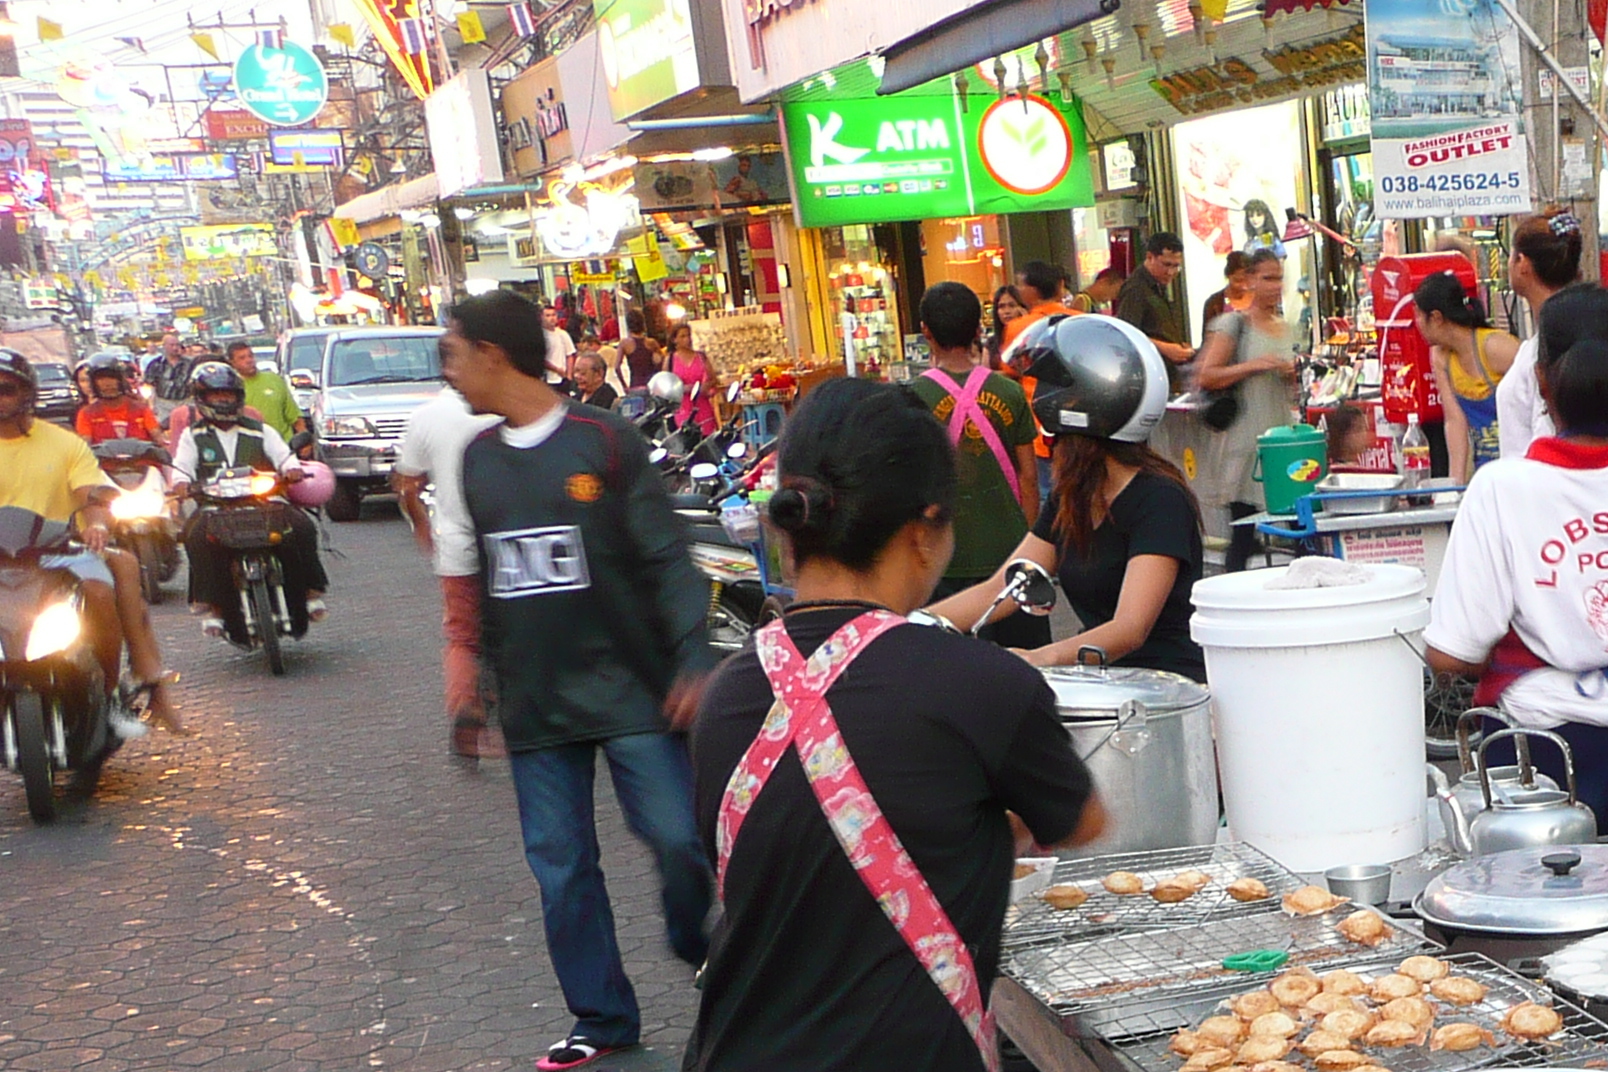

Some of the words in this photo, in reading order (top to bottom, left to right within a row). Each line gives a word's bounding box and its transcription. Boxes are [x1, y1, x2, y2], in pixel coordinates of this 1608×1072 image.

[806, 111, 871, 167] K
[876, 118, 950, 152] ATM
[1407, 135, 1512, 167] OUTLET
[1381, 172, 1520, 193] 038-425624-5
[1384, 193, 1522, 211] www.balihaiplaza.com
